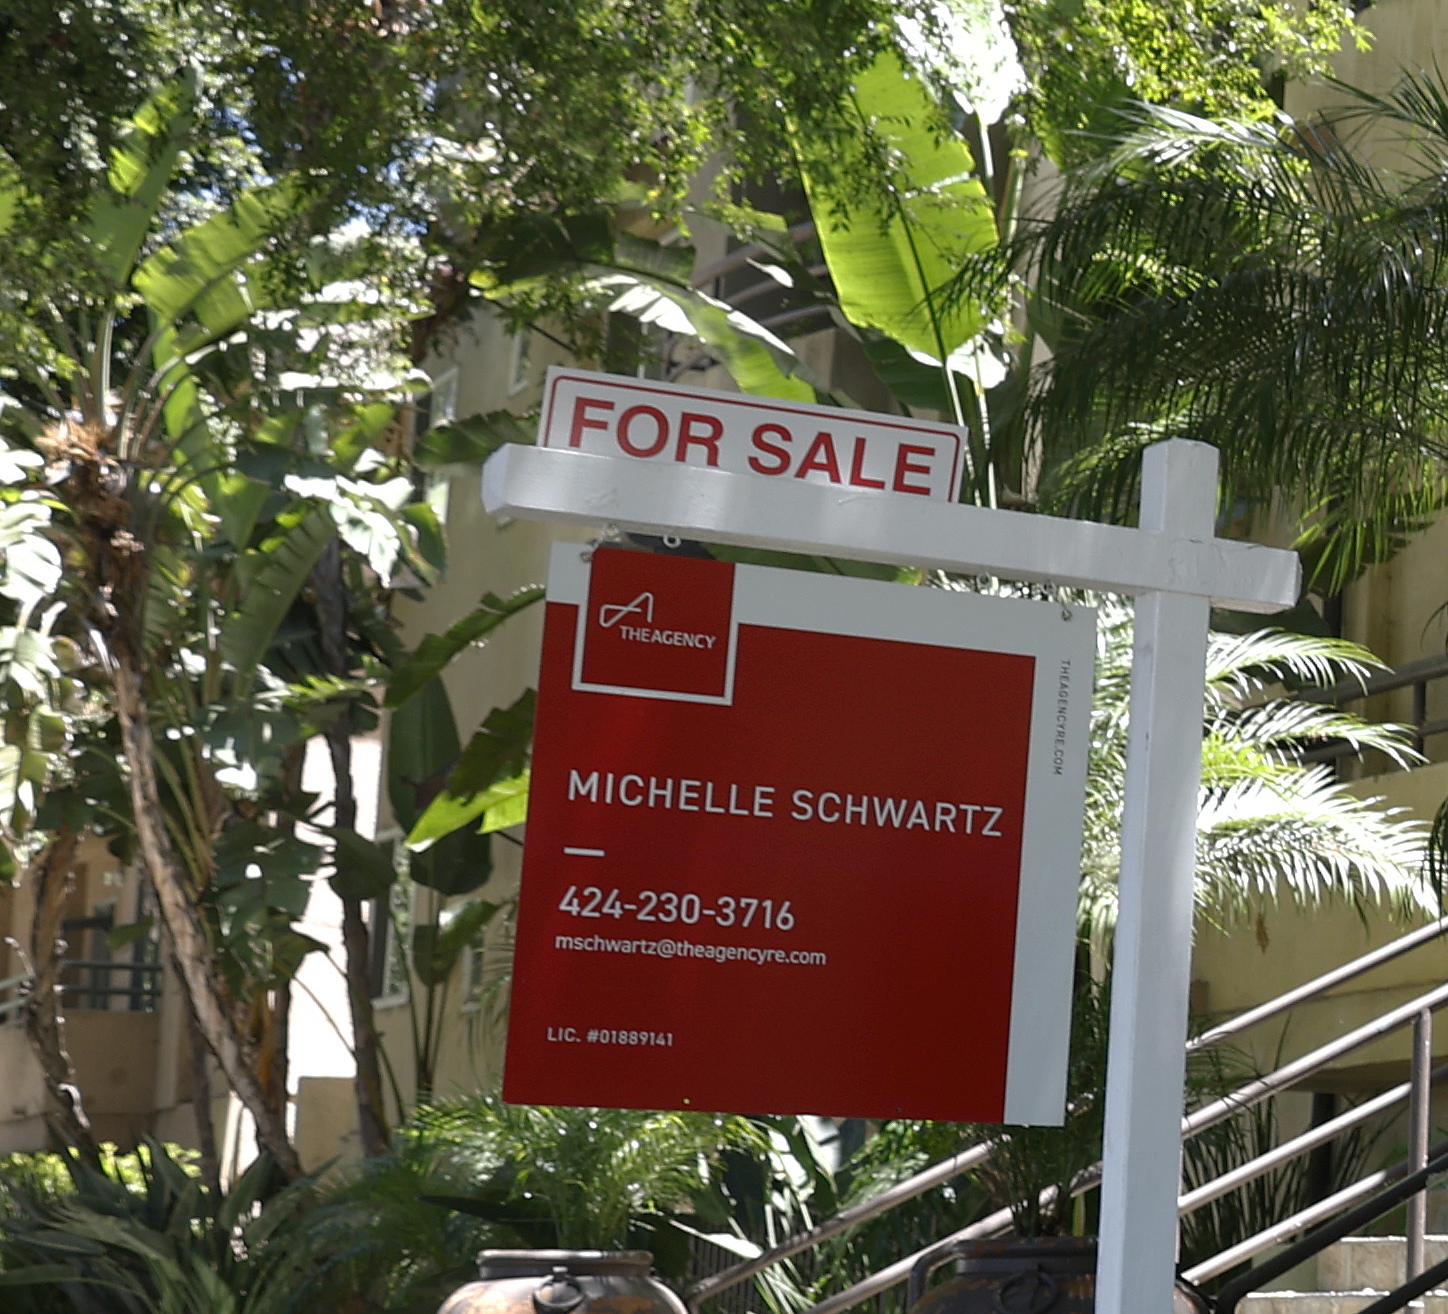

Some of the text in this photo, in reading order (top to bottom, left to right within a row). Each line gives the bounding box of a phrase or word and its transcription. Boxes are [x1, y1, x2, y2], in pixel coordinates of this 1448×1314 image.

[568, 396, 937, 496] FOR SALE
[619, 624, 717, 650] THEAGENCY
[1053, 659, 1071, 776] THEAGENCYRE.COM
[566, 768, 1004, 837] MICHELLE SCHWARTZ
[558, 885, 795, 931] 424-230-3716
[554, 934, 827, 966] mschwartz@theagencyre.com
[546, 1026, 674, 1047] LIC. #01889141
